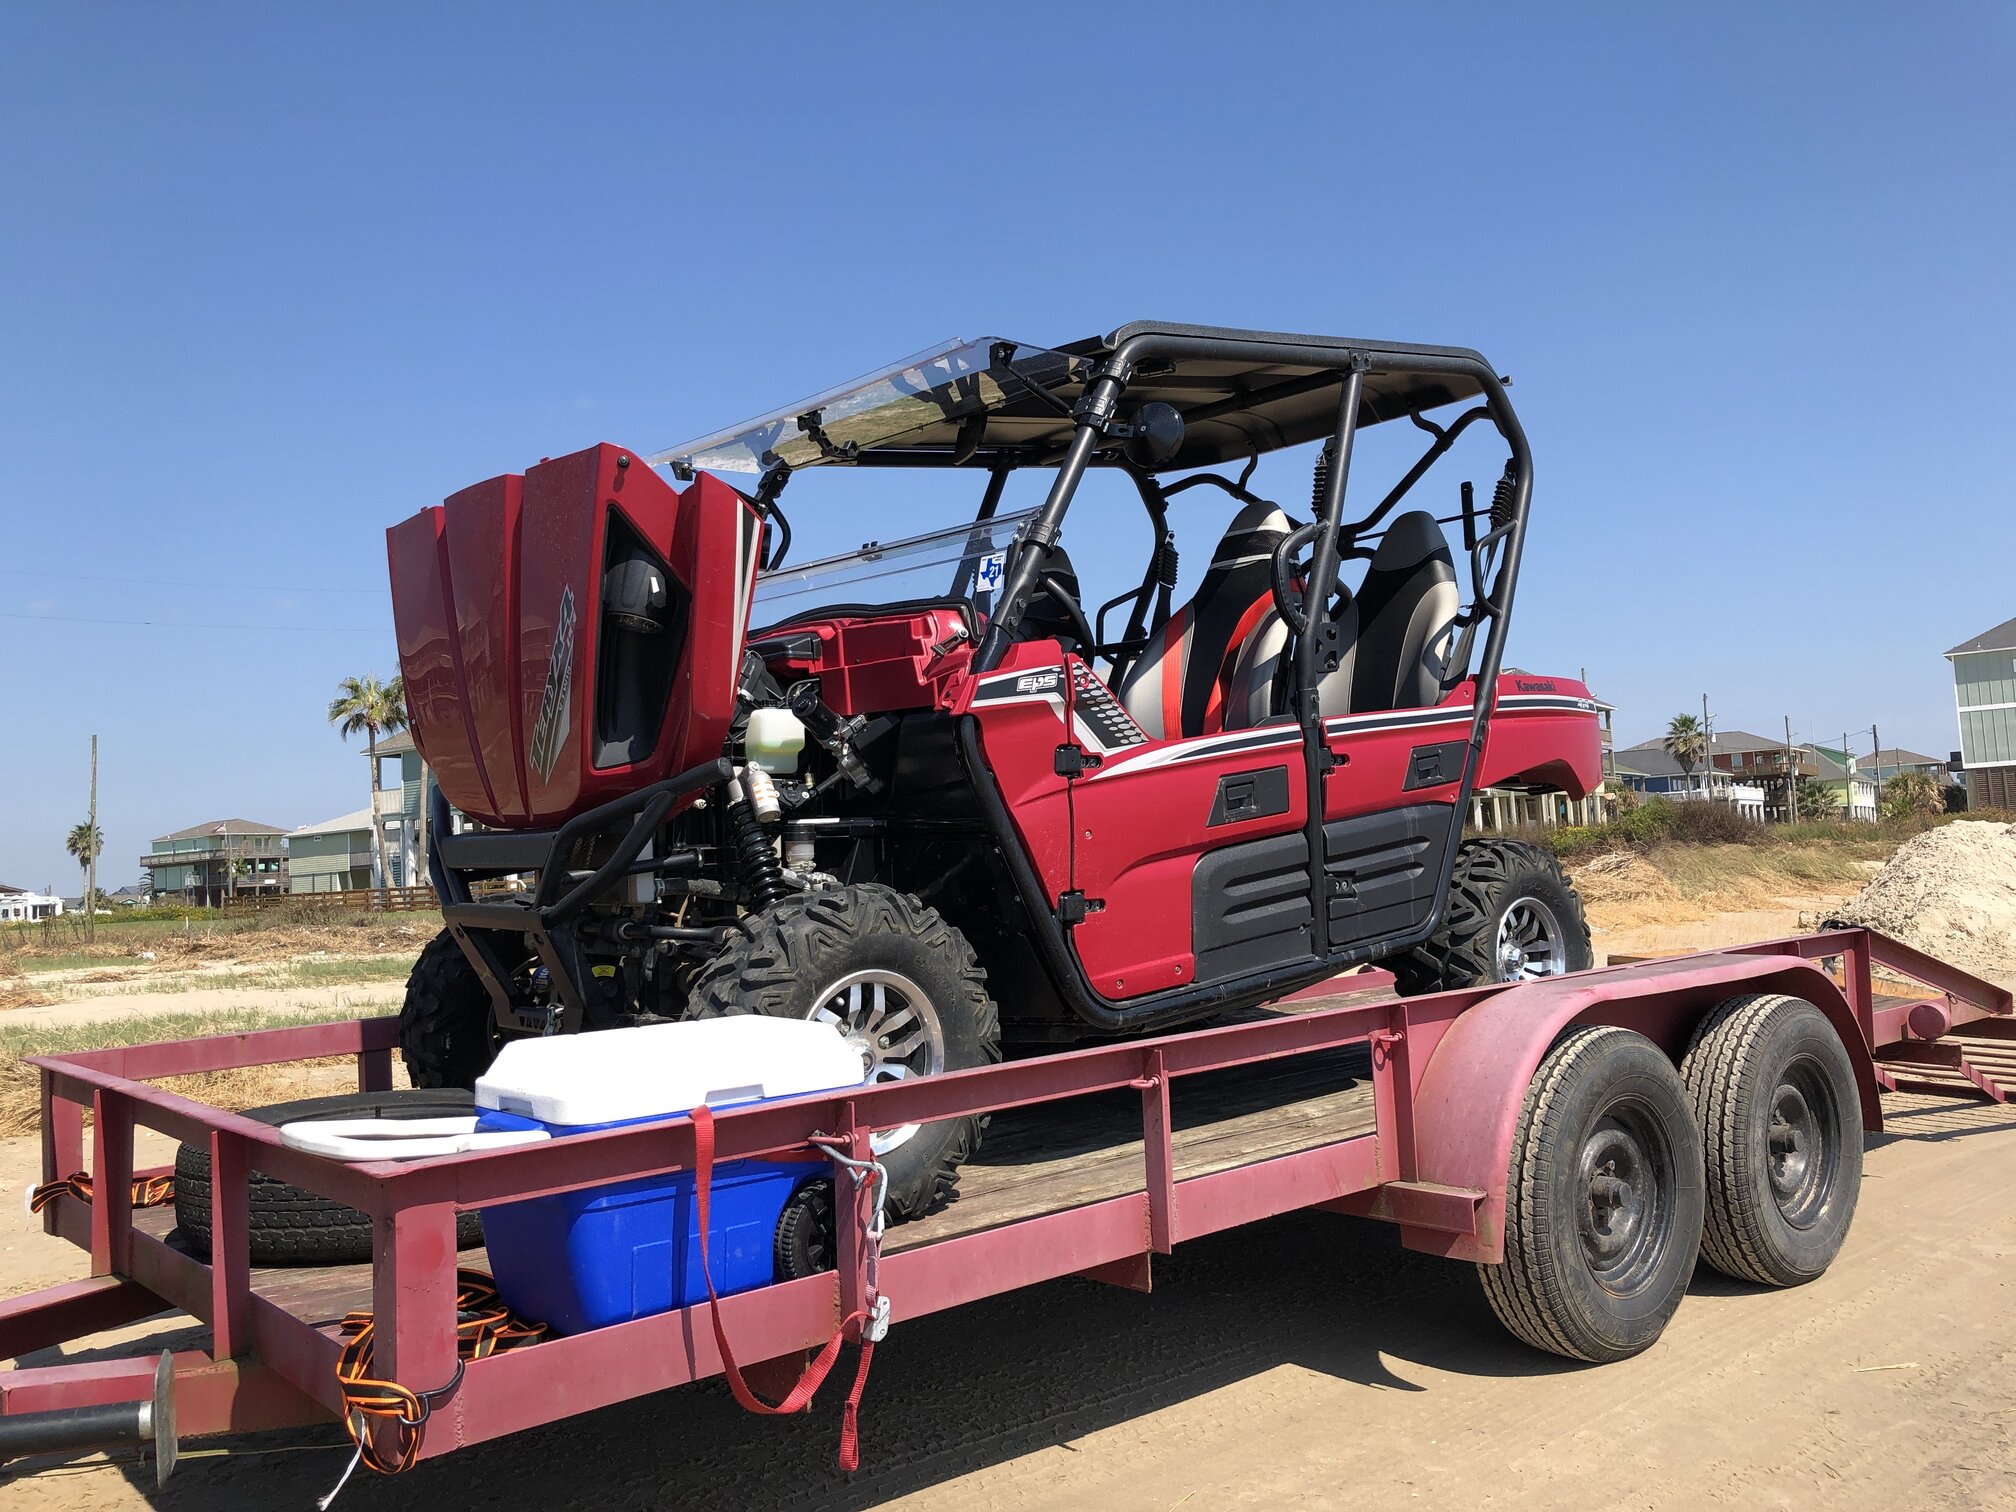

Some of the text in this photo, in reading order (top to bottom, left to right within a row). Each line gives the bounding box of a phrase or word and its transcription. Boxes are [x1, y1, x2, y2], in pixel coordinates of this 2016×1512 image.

[989, 564, 999, 578] 21
[1017, 673, 1058, 693] EPS
[1515, 680, 1557, 692] Kawasaki
